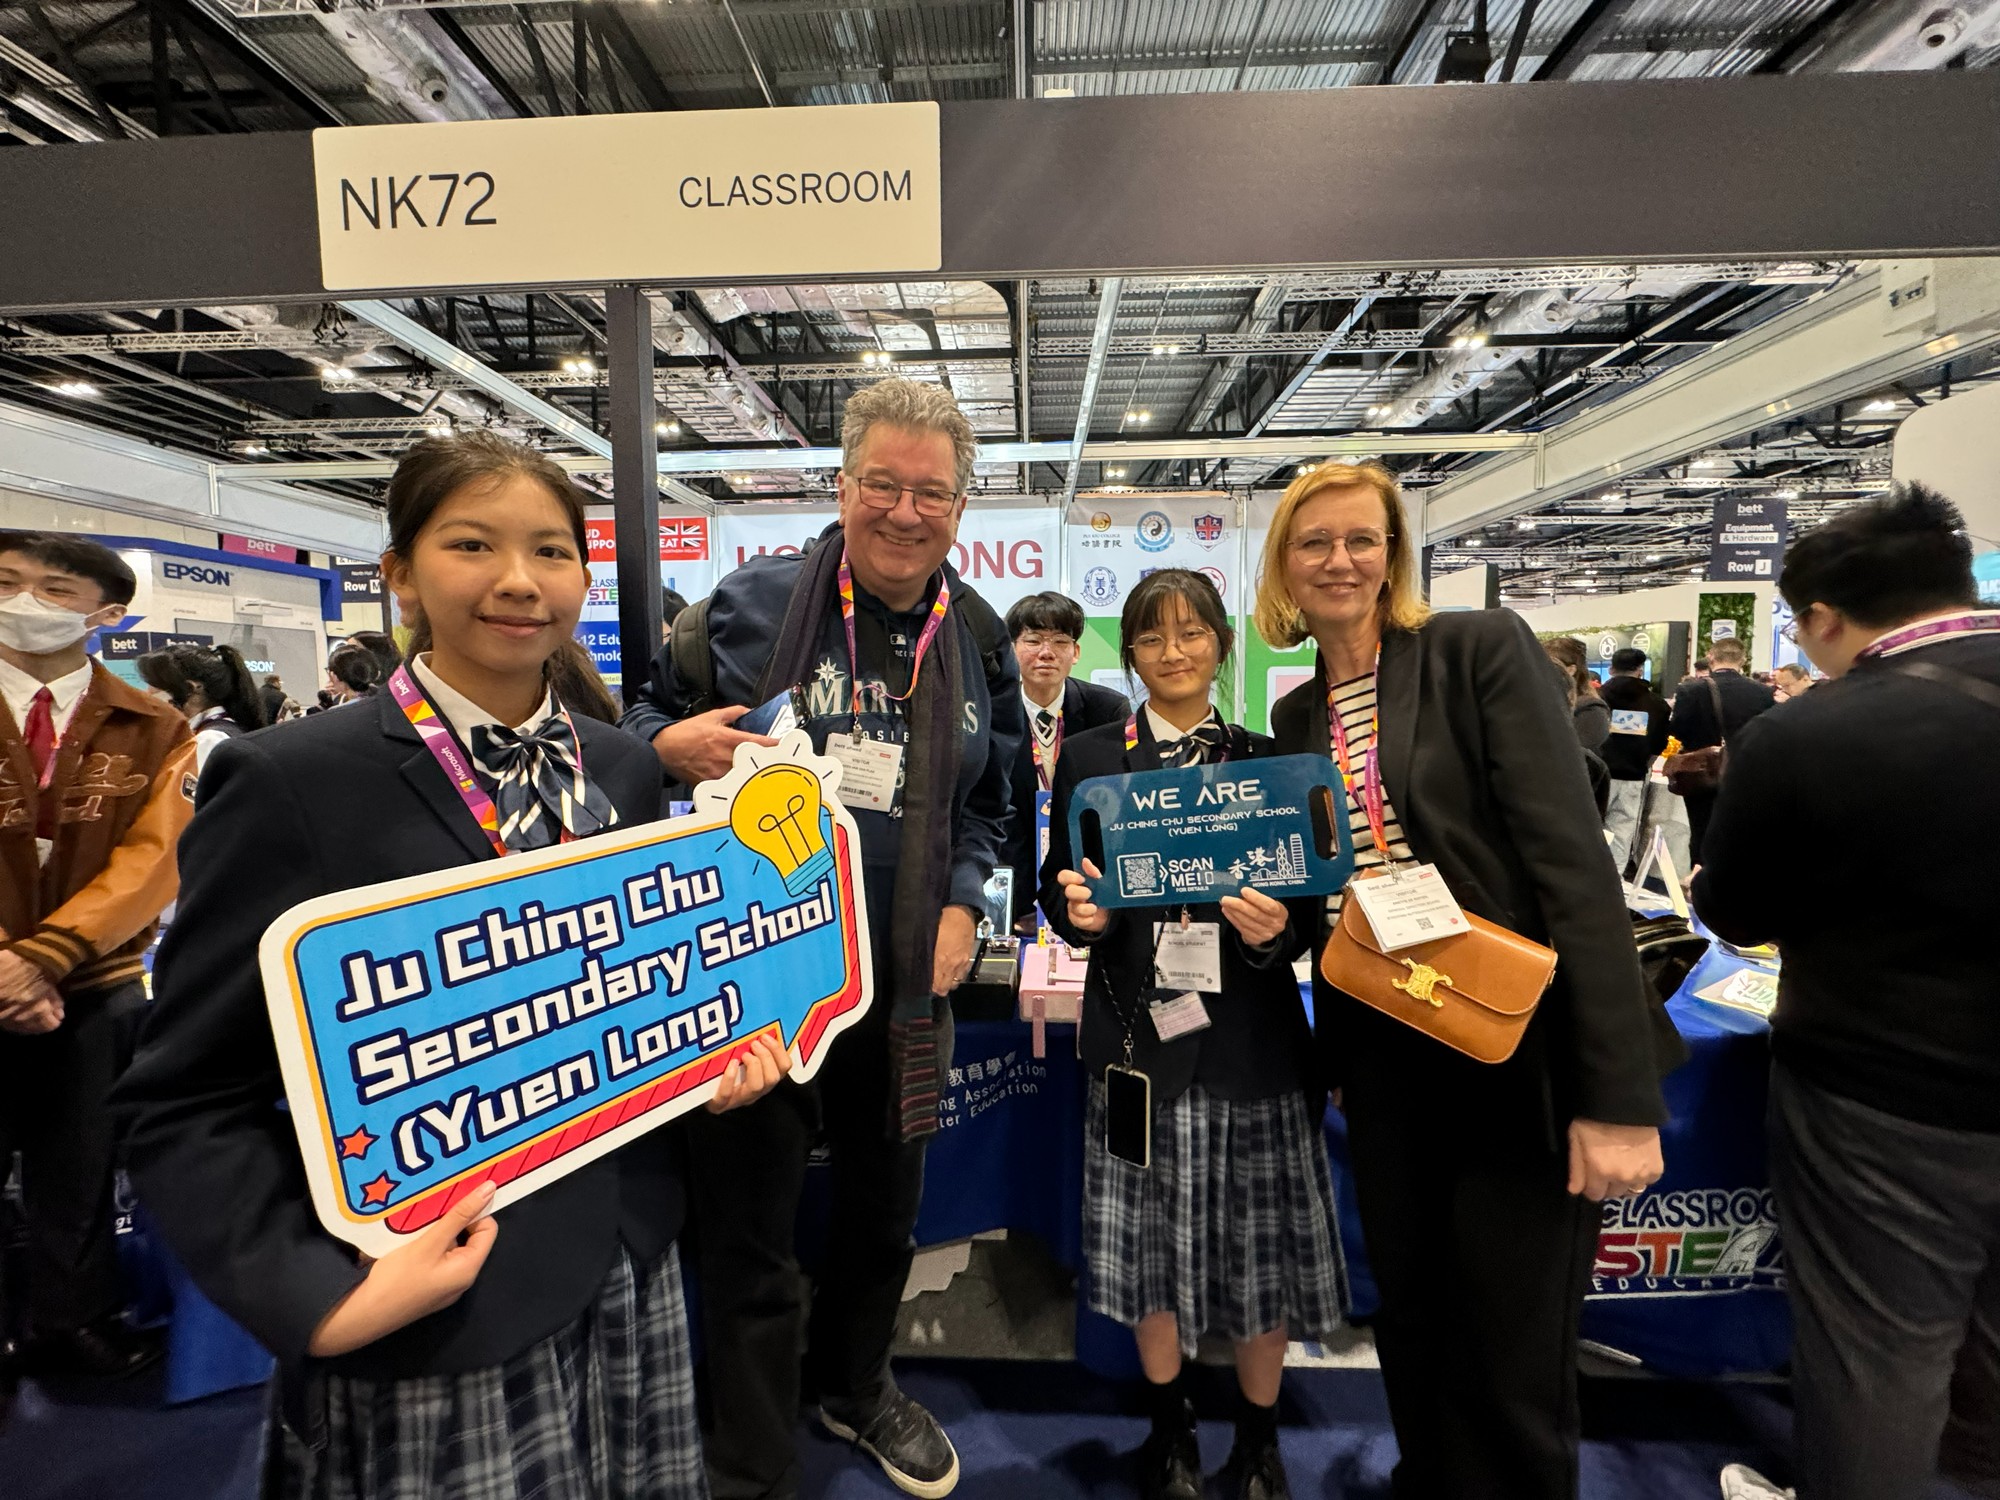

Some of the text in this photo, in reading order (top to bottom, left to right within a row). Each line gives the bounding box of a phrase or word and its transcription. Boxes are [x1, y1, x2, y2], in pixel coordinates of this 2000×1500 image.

[340, 170, 913, 231] NK72 CLASSROOM
[1737, 503, 1764, 514] bett
[1725, 523, 1774, 533] Equipment
[659, 538, 678, 548] EAT
[1732, 534, 1775, 542] Hardware
[951, 540, 1044, 579] ONG
[1727, 561, 1754, 572] Row
[163, 562, 231, 586] EPSON
[344, 581, 367, 592] Row
[588, 588, 618, 601] STE
[112, 638, 138, 650] bett
[599, 633, 621, 646] Edu
[243, 660, 275, 673] PSON
[395, 677, 410, 696] bett
[440, 746, 468, 780] Microsoft
[1132, 779, 1262, 812] WE ARE
[1109, 806, 1300, 832] JU CHING CHU SECONDARY SCHOOL
[1168, 822, 1238, 837] (YUEN LONG)
[1168, 857, 1214, 873] SCAN
[1227, 846, 1275, 880] 香港
[1170, 873, 1202, 888] ME!
[342, 864, 721, 1018] Ju Ching Chu
[357, 881, 834, 1099] Secondary School
[397, 985, 743, 1171] (Yuen Long)
[948, 1050, 1017, 1087] 教育學
[970, 1079, 1038, 1118] Education
[1602, 1189, 1779, 1229] CLASSROO
